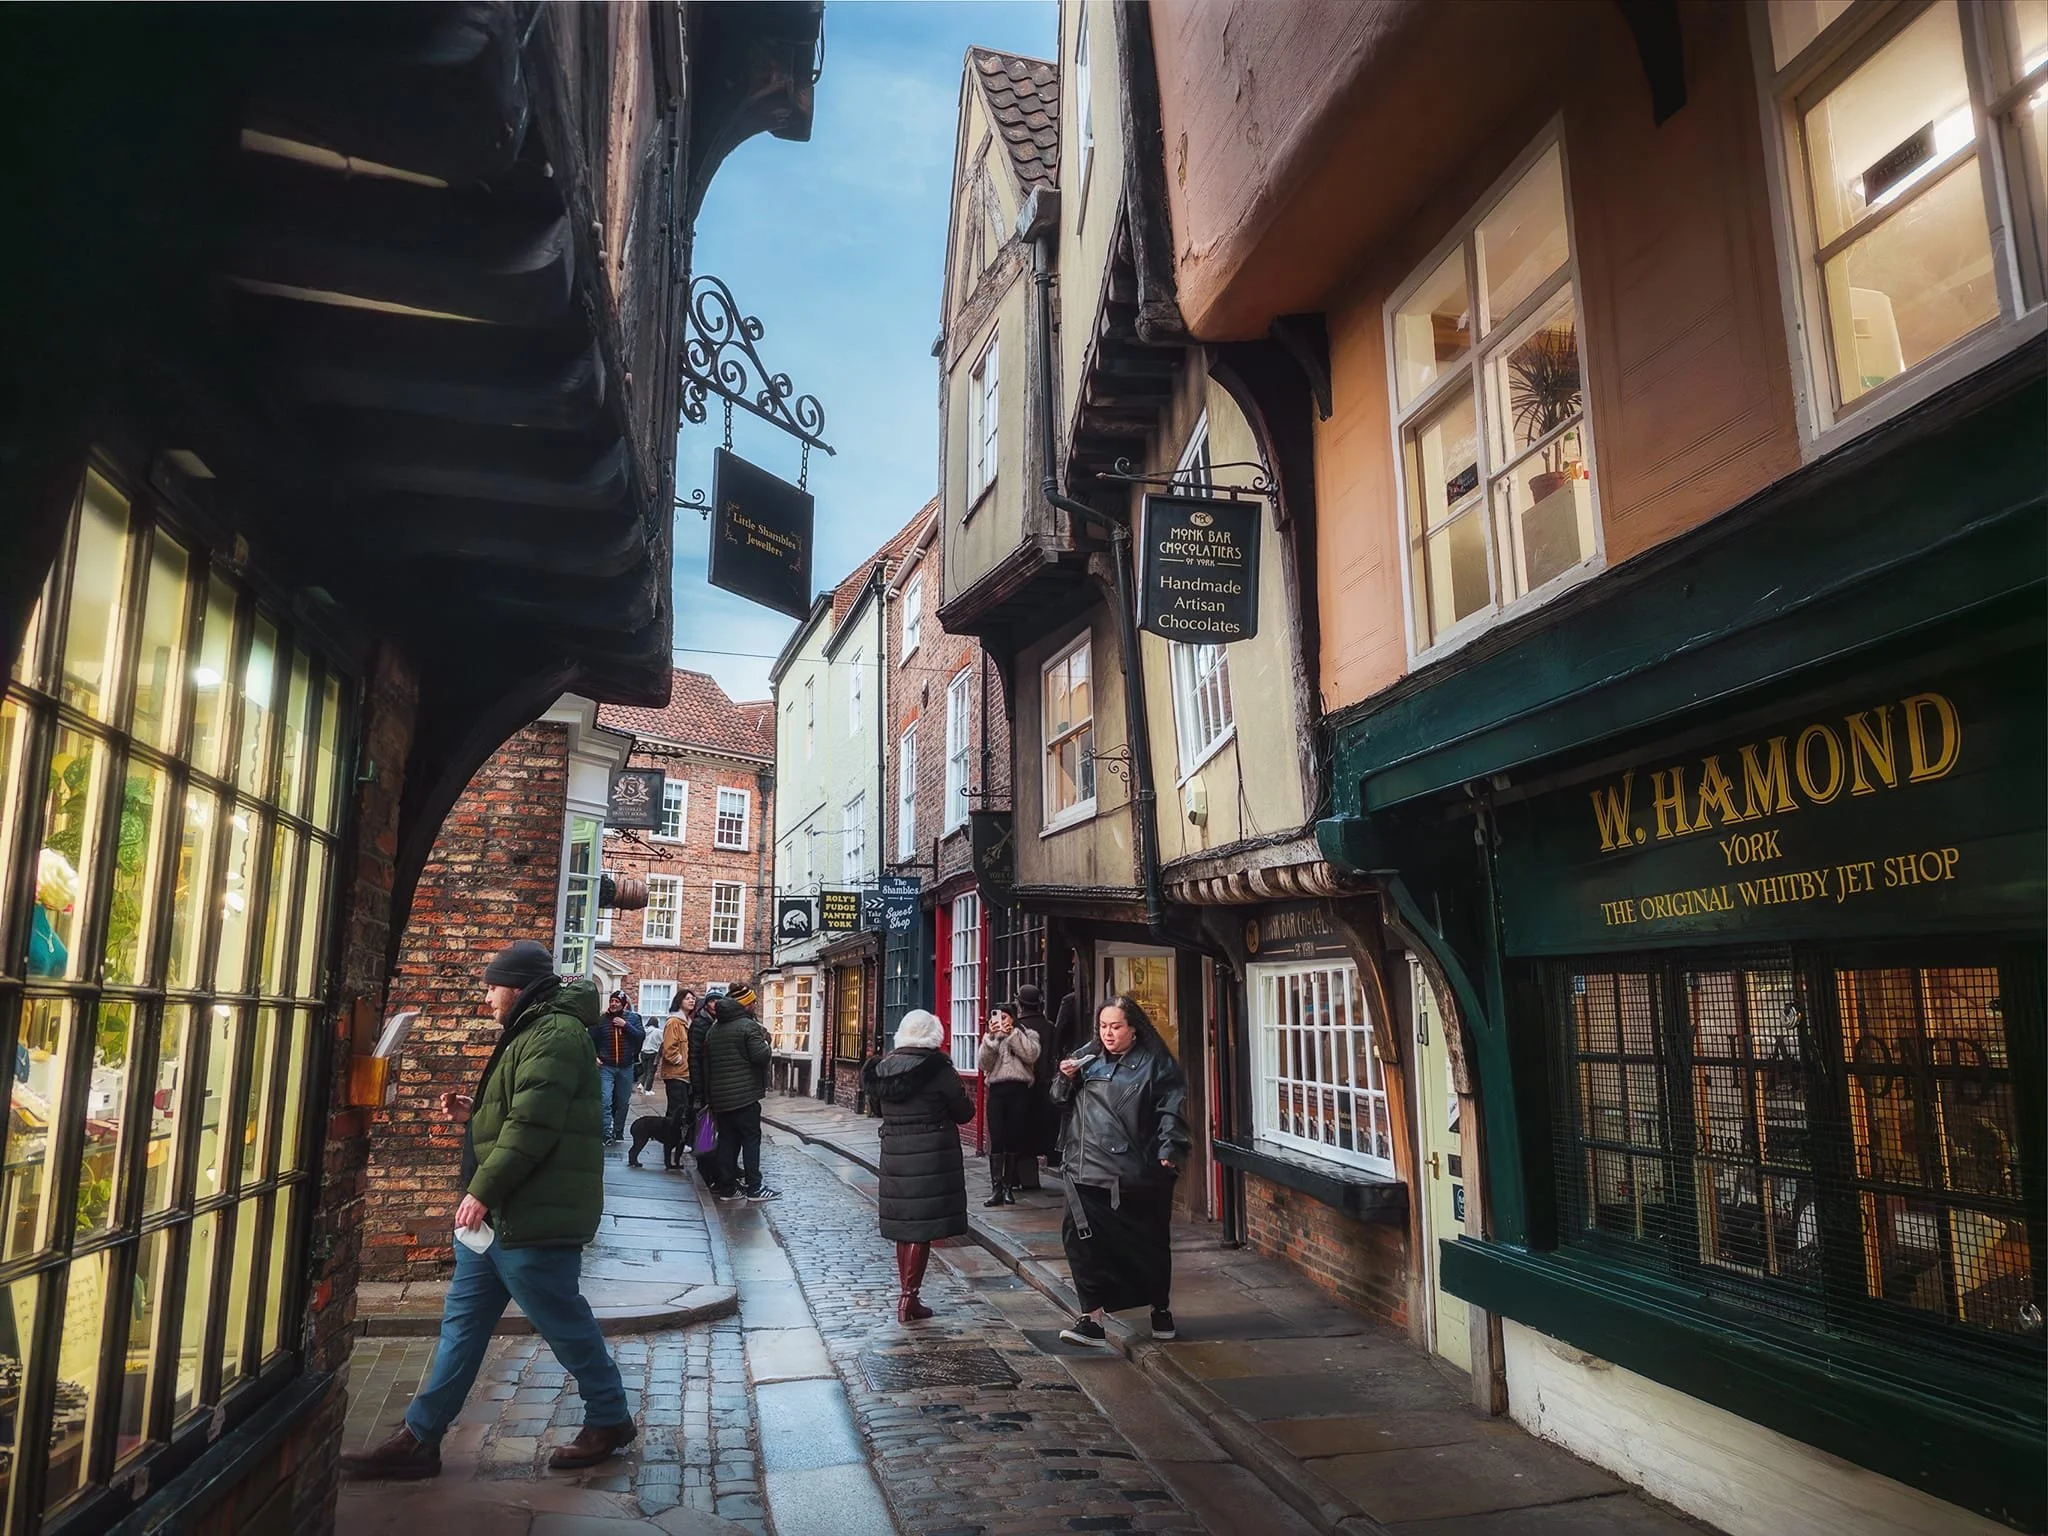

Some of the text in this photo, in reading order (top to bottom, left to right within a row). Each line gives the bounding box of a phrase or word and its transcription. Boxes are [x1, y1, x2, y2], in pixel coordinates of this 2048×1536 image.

[733, 512, 796, 550] Little Shambles
[1171, 528, 1231, 544] MONK BAR
[746, 533, 782, 557] Jewellers
[1160, 541, 1242, 559] CHOCOLATIERS
[1196, 558, 1216, 567] YORK
[1160, 576, 1241, 594] Handmade
[1174, 596, 1225, 612] Artisan
[1158, 614, 1241, 633] Chocolates
[1651, 692, 1961, 840] HAMOND
[1719, 829, 1783, 867] YORK
[882, 885, 919, 895] Shambles
[894, 878, 907, 886] The
[1601, 847, 1960, 926] THE ORIGINAL WHITBY JET SHOP
[885, 904, 913, 919] Sweet
[889, 917, 911, 930] Shop
[1281, 912, 1297, 939] BAR
